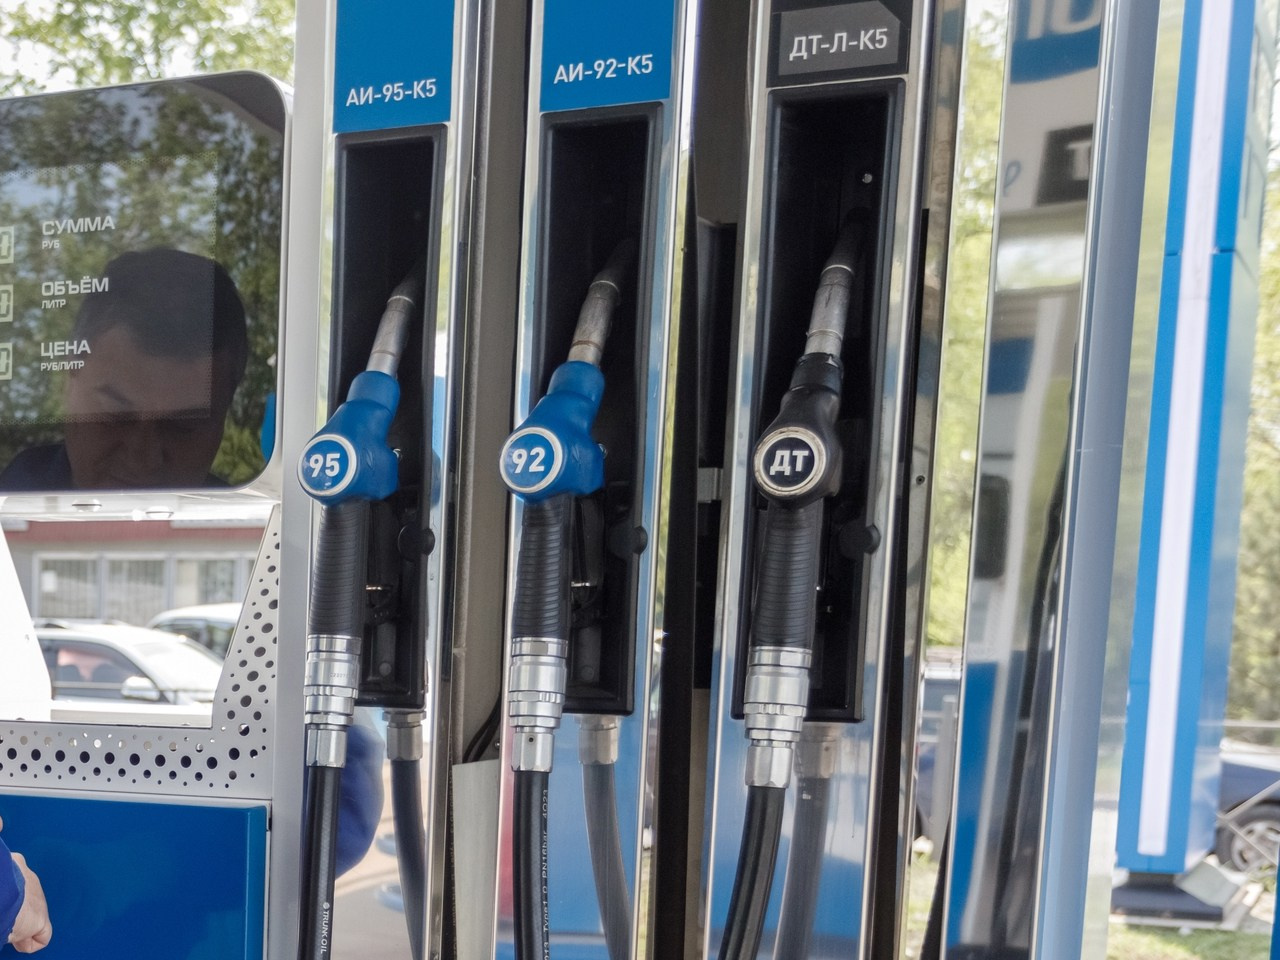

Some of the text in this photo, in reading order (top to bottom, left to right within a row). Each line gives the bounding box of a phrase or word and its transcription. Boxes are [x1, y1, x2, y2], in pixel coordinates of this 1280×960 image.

[789, 28, 888, 61] ДТ-Л-К5
[554, 54, 654, 84] АИ-92-К5
[345, 78, 436, 107] АИ-95-К5
[42, 215, 115, 236] СУММА
[42, 240, 60, 250] РУБ
[41, 276, 109, 297] ОБЪЁМ
[41, 299, 67, 309] ЛИТР
[40, 339, 91, 359] ЦЕНА
[40, 360, 85, 371] РУБ/ЛИТР
[309, 453, 340, 477] 95
[512, 447, 546, 474] 92
[769, 450, 809, 475] ДТ
